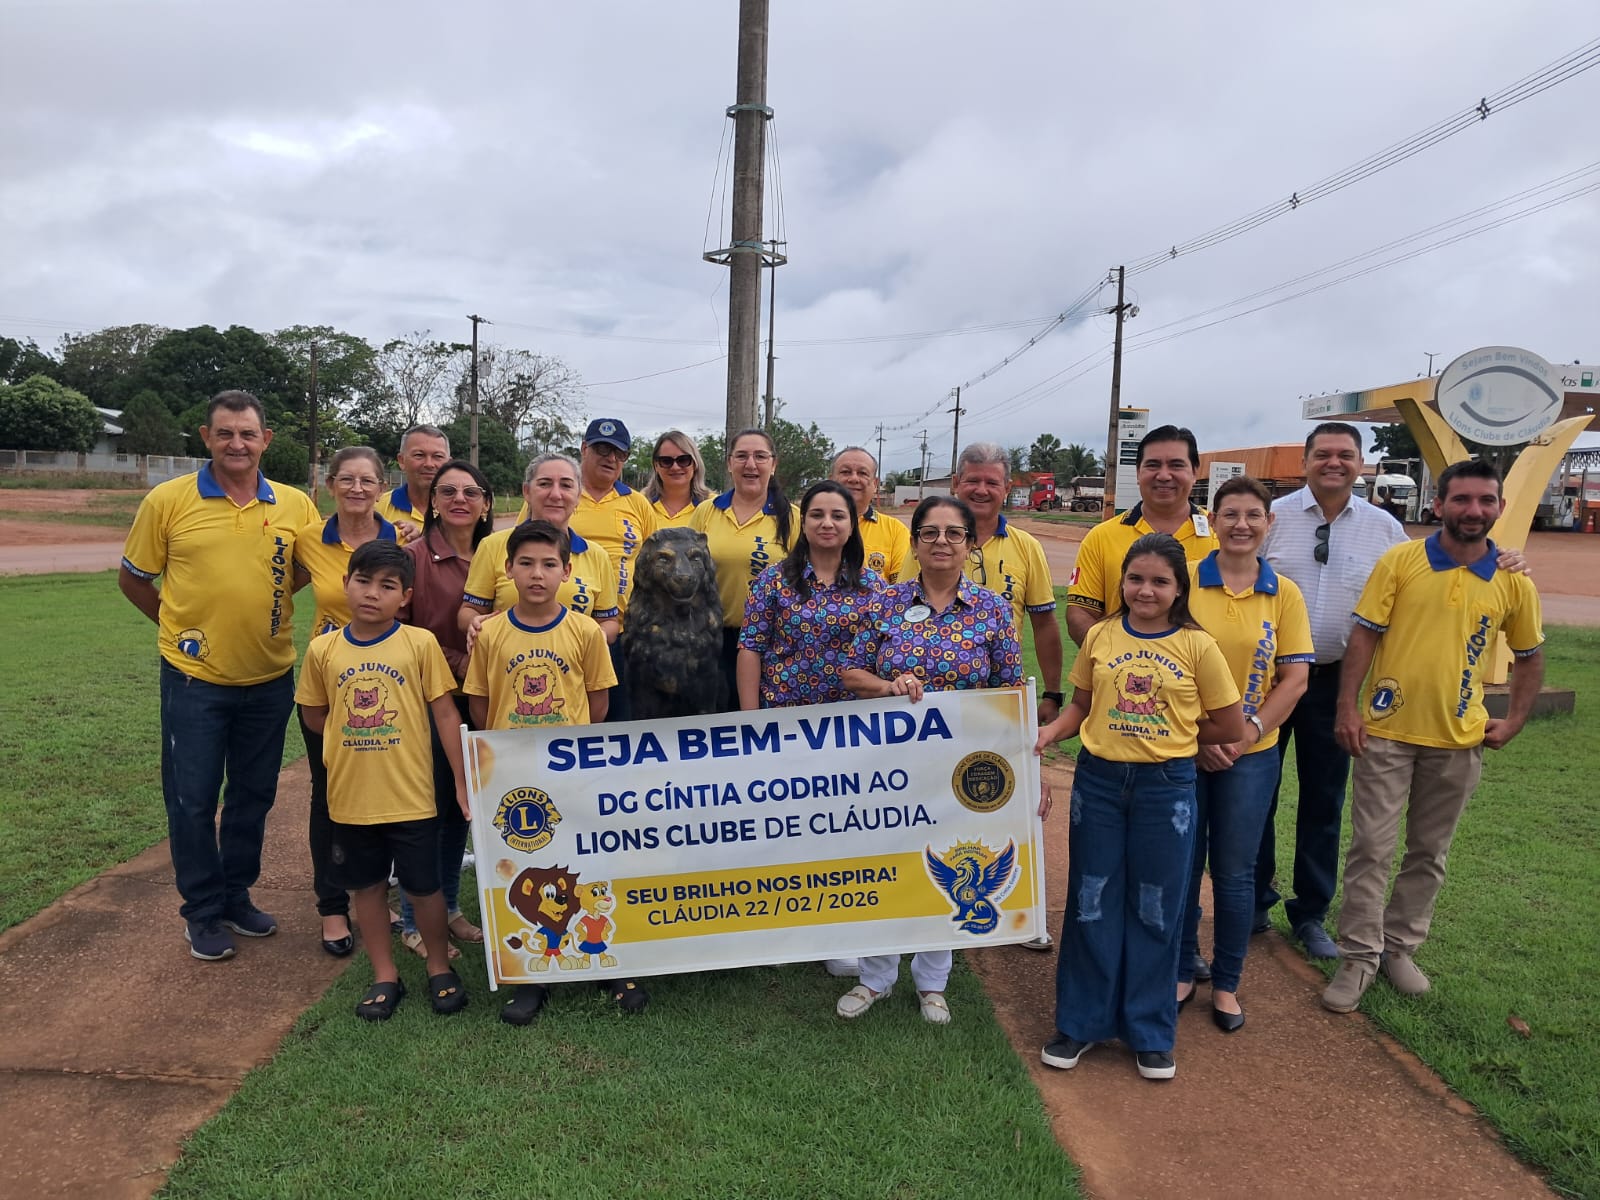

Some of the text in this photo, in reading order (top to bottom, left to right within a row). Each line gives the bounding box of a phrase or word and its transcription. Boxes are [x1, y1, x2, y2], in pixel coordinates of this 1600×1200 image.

[1461, 351, 1548, 377] Sejam Bem Vindos
[1449, 411, 1471, 434] Lions
[1474, 428, 1500, 441] Clube
[1503, 431, 1515, 440] de
[1518, 415, 1551, 438] Cláudia
[617, 519, 637, 595] LIONS CLUBE
[271, 536, 288, 637] LIONS CLUBE
[1252, 619, 1275, 671] LIONS
[337, 662, 405, 688] LEO JUNIOR
[505, 649, 571, 675] LEO JUNIOR
[1107, 650, 1184, 680] LEO JUNIOR
[1455, 614, 1492, 718] LIONS CLUBE
[388, 737, 401, 745] MT
[547, 707, 953, 772] SEJA BEM-VINDA
[1108, 722, 1150, 734] CLÁUDIA
[1157, 728, 1170, 737] MT
[505, 789, 545, 804] LIONS
[597, 768, 909, 816] DG CÍNTIA GODRIN AO
[517, 806, 538, 831] L
[575, 804, 938, 856] LIONS CLUBE DE CLÁUDIA.
[509, 835, 549, 849] INTERNATIONAL
[625, 866, 897, 905] SEU BRILHO NOS INSPIRA!
[648, 890, 880, 926] CLÁUDIA 22 / 02 / 2026
